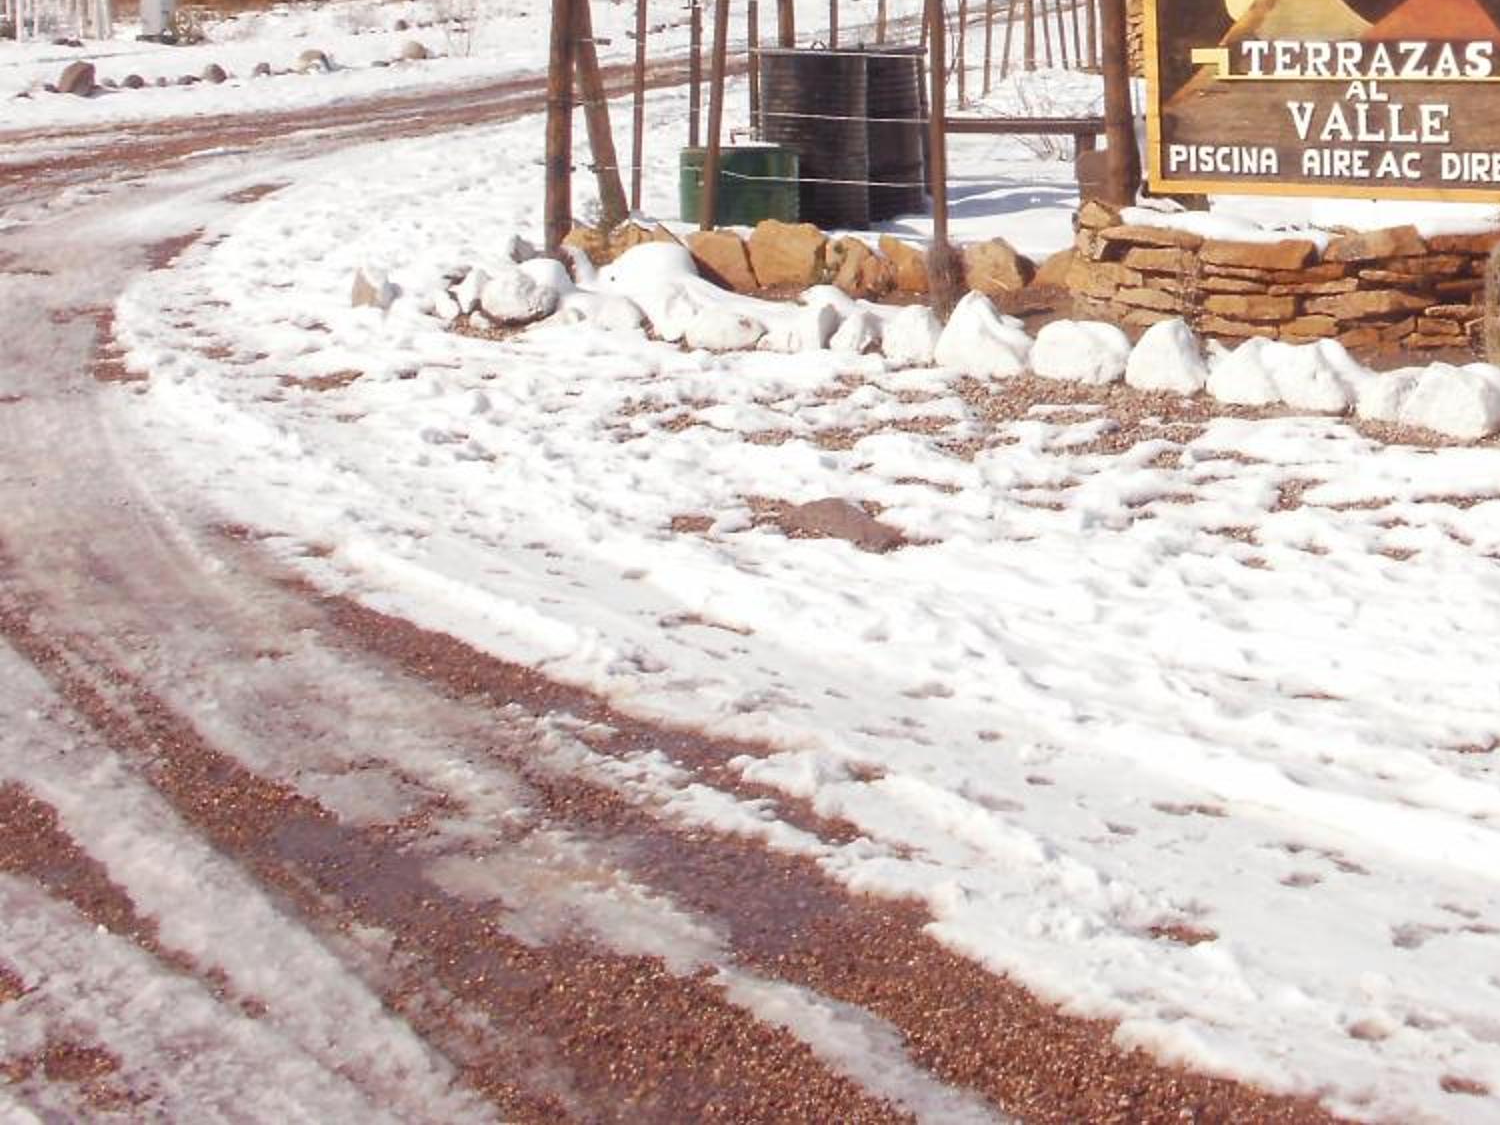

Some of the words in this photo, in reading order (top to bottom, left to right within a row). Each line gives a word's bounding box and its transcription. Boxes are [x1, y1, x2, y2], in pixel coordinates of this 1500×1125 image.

[1241, 40, 1493, 78] TERRAZAS
[1345, 81, 1389, 102] AL
[1287, 101, 1450, 144] VALLE
[1169, 146, 1278, 174] PISCINA
[1302, 150, 1368, 178] AIRE
[1375, 152, 1421, 179] AC
